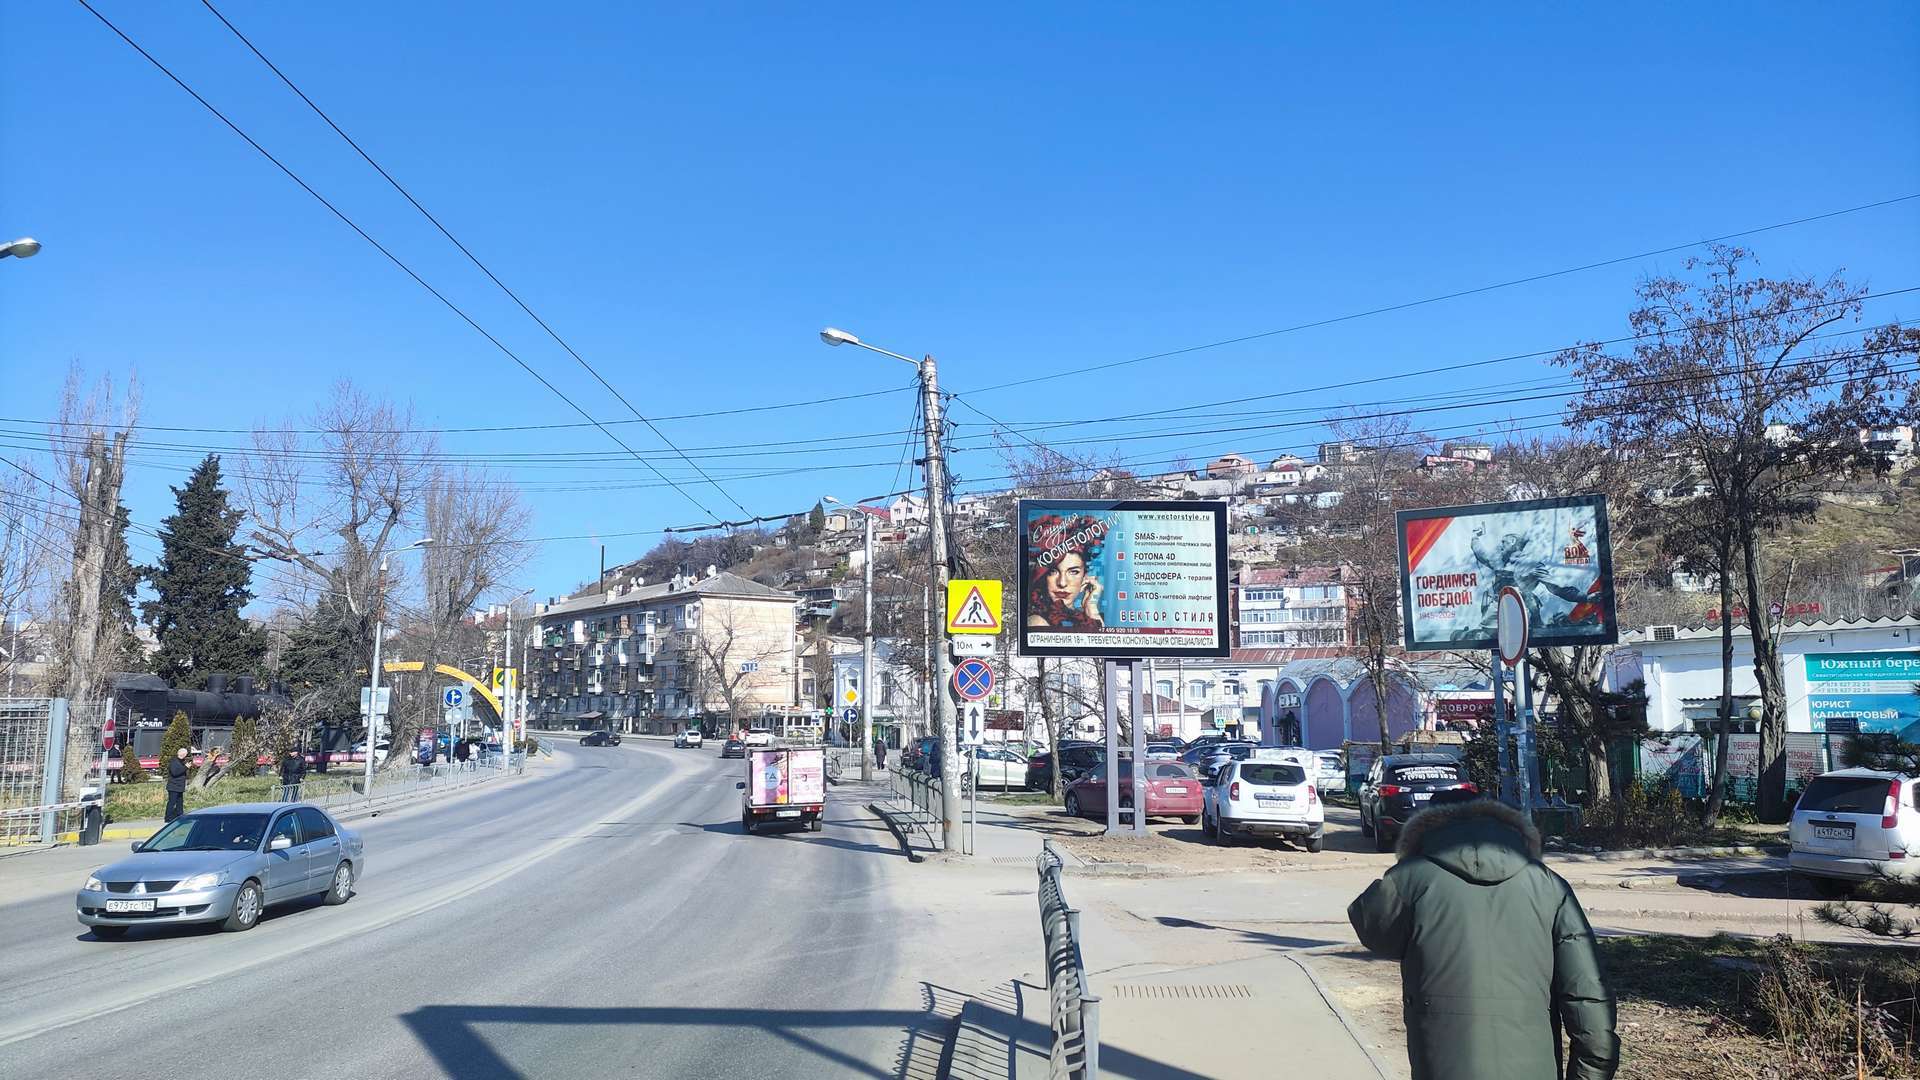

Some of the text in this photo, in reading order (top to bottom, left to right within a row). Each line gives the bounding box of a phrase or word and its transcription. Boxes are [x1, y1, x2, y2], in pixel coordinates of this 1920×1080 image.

[1137, 514, 1210, 522] www.vectorstyle.ru
[1037, 511, 1121, 567] КОСМЕТОЛОГИИ
[1133, 552, 1176, 561] FOTONA 4D
[1133, 572, 1182, 581] ЭНДОСФЕРА
[1416, 572, 1477, 590] ГОРДИМСЯ
[1417, 590, 1473, 608] ПОБЕДОЙ!
[1121, 611, 1214, 623] ВЕКТОР СТИЛЯ
[1029, 634, 1073, 644] ОГРАНИЧЕНИЯ
[1087, 635, 1122, 645] ТРЕБУЕТСЯ
[1122, 636, 1169, 646] КОНСУЛЬТАЦИЯ
[1170, 636, 1214, 647] СПЕЦИАЛИСТА
[1821, 657, 1920, 671] Южный бере
[1811, 700, 1852, 708] ЮРИСТ
[1812, 709, 1899, 719] КАДАСТРОВЫЙ
